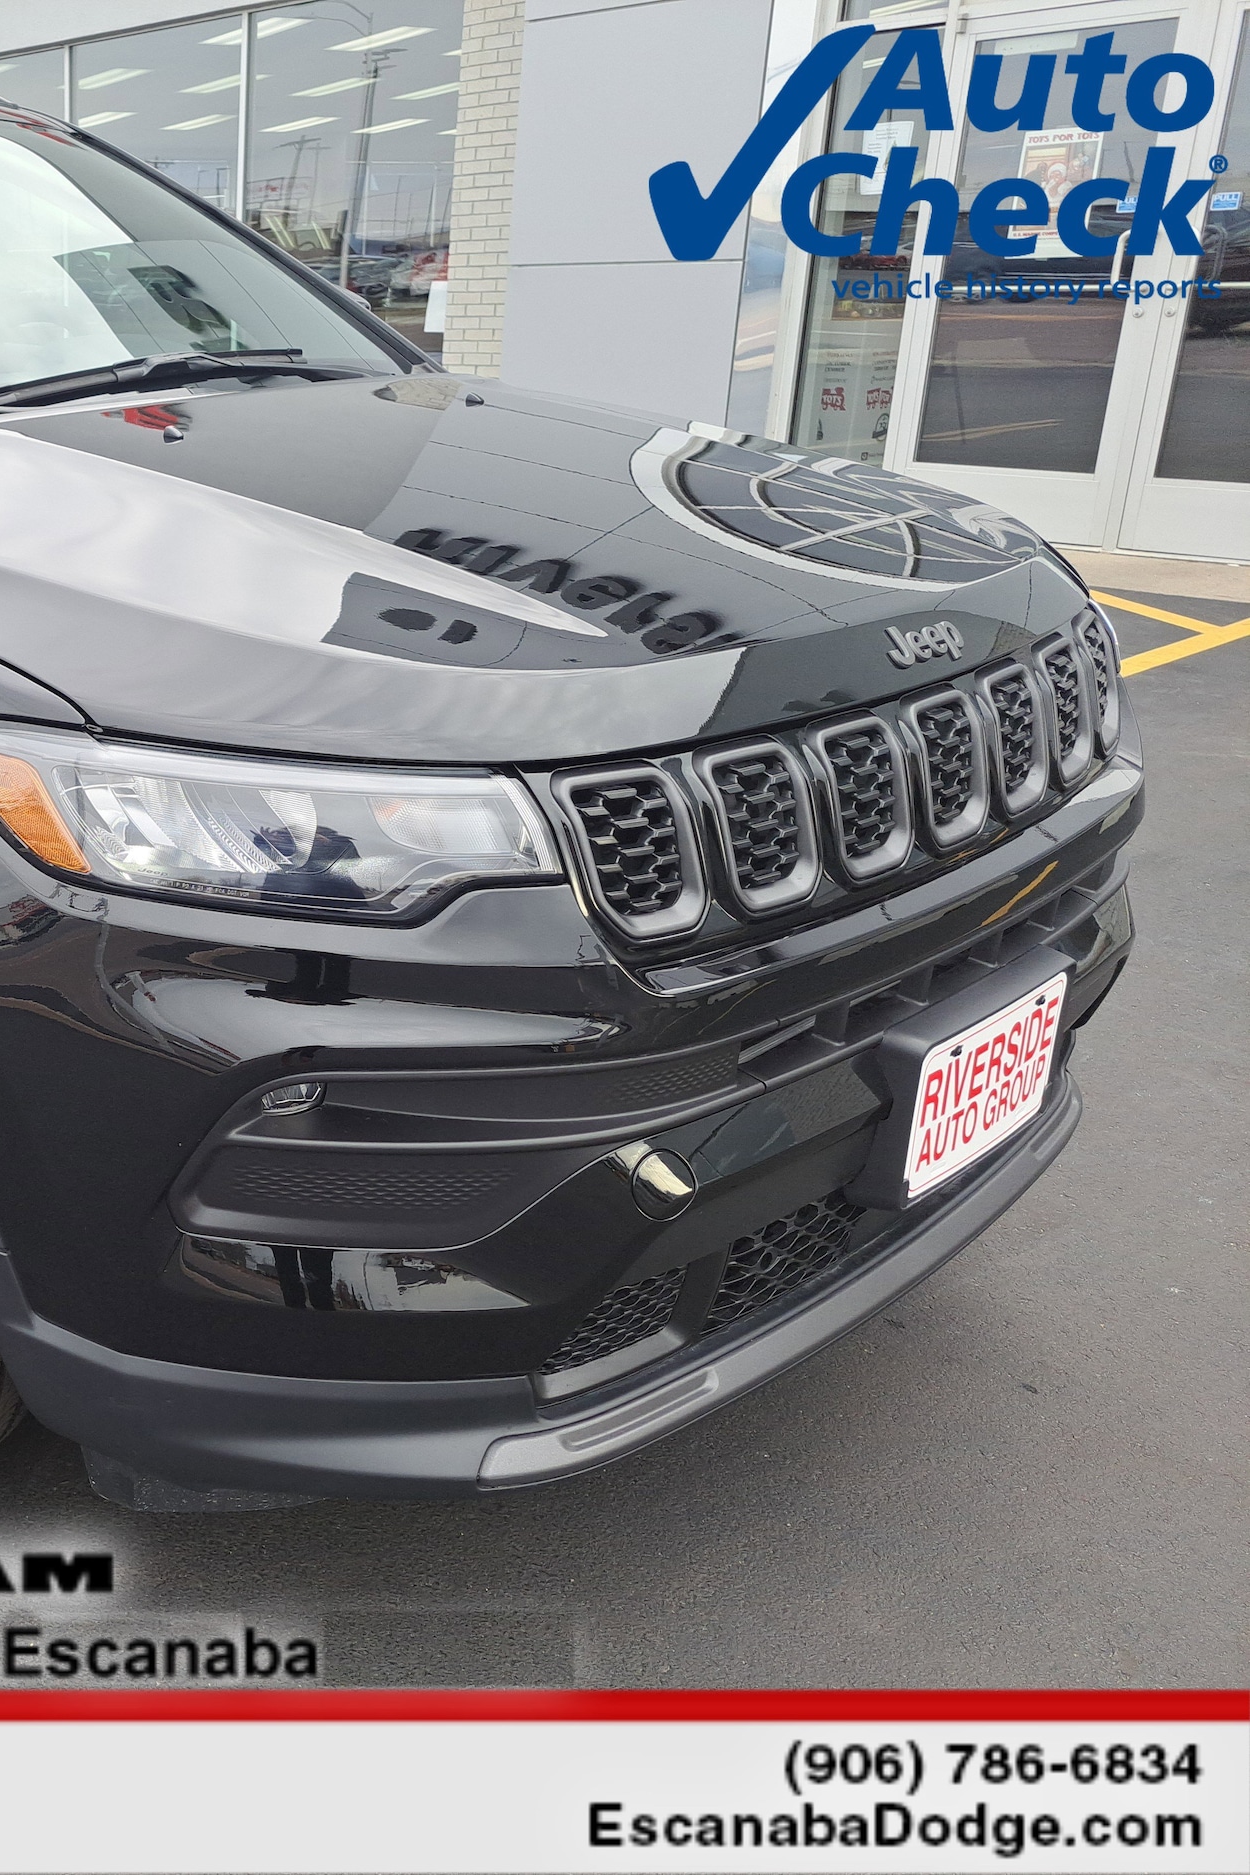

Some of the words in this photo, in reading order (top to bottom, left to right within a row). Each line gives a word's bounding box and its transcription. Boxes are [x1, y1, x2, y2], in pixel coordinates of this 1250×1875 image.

[1053, 133, 1074, 142] FOR
[883, 620, 964, 670] Jeep
[919, 995, 1059, 1128] RIVERSIDE
[914, 1101, 979, 1173] AUTO
[982, 1053, 1046, 1132] GROUP
